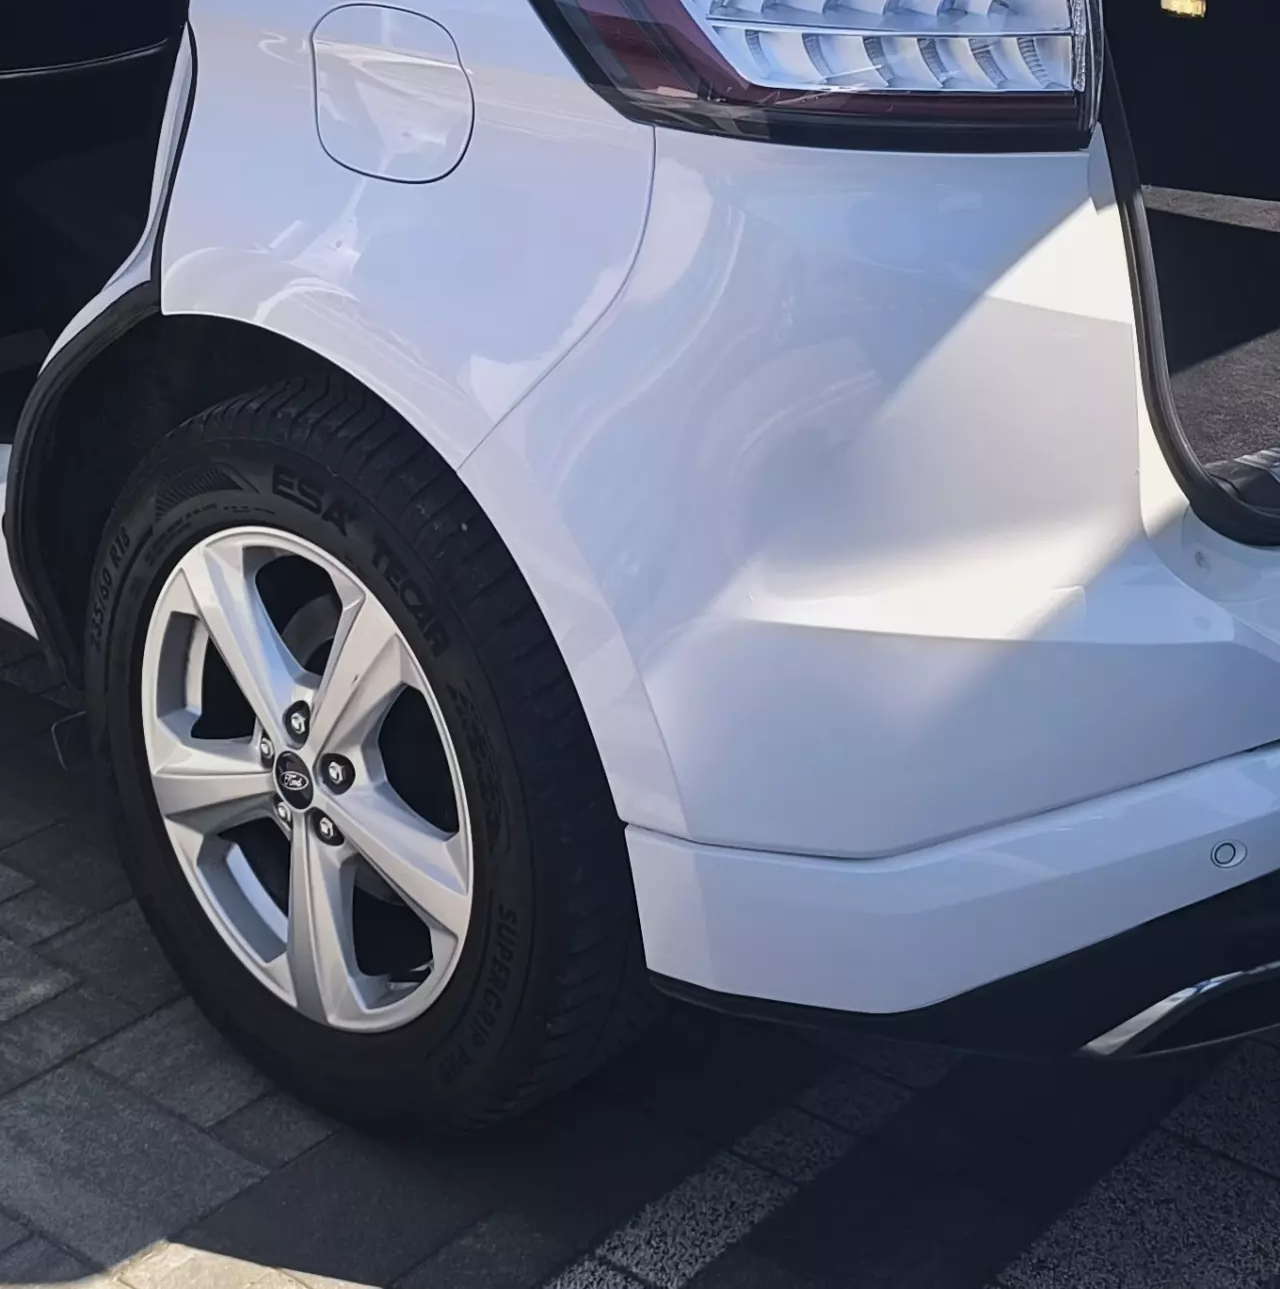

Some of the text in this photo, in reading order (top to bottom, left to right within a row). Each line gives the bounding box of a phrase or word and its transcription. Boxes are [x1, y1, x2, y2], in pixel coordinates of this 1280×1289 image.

[109, 526, 131, 569] R18
[371, 531, 450, 659] TECAR
[469, 902, 519, 1050] SUPERGRIP
